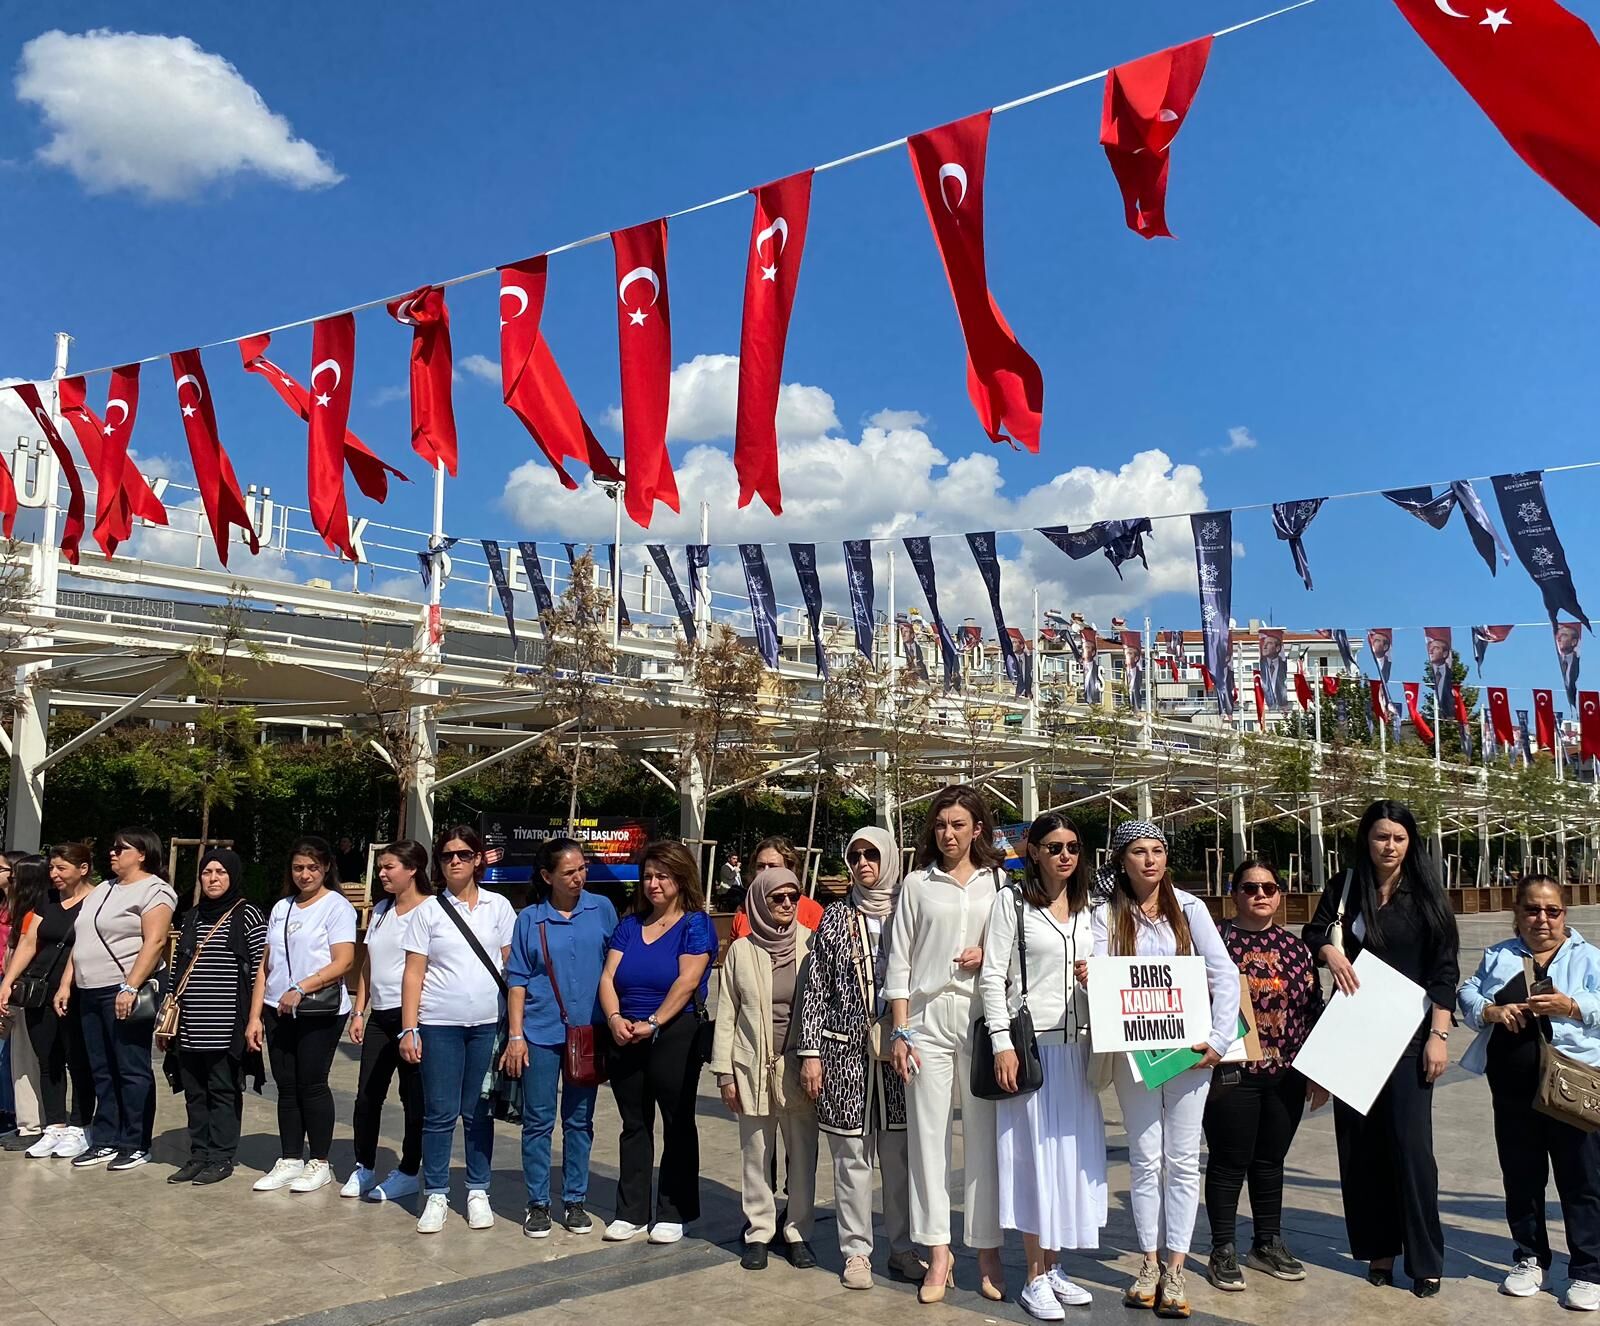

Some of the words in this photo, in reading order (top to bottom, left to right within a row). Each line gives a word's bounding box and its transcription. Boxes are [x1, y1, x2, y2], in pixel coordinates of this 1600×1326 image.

[513, 826, 550, 840] TİYATRO
[591, 830, 630, 843] BAŞLIYOR
[1129, 964, 1173, 994] BARIŞ
[1123, 989, 1182, 1013] KADINLA
[1123, 1014, 1185, 1042] MÜMKÜN
